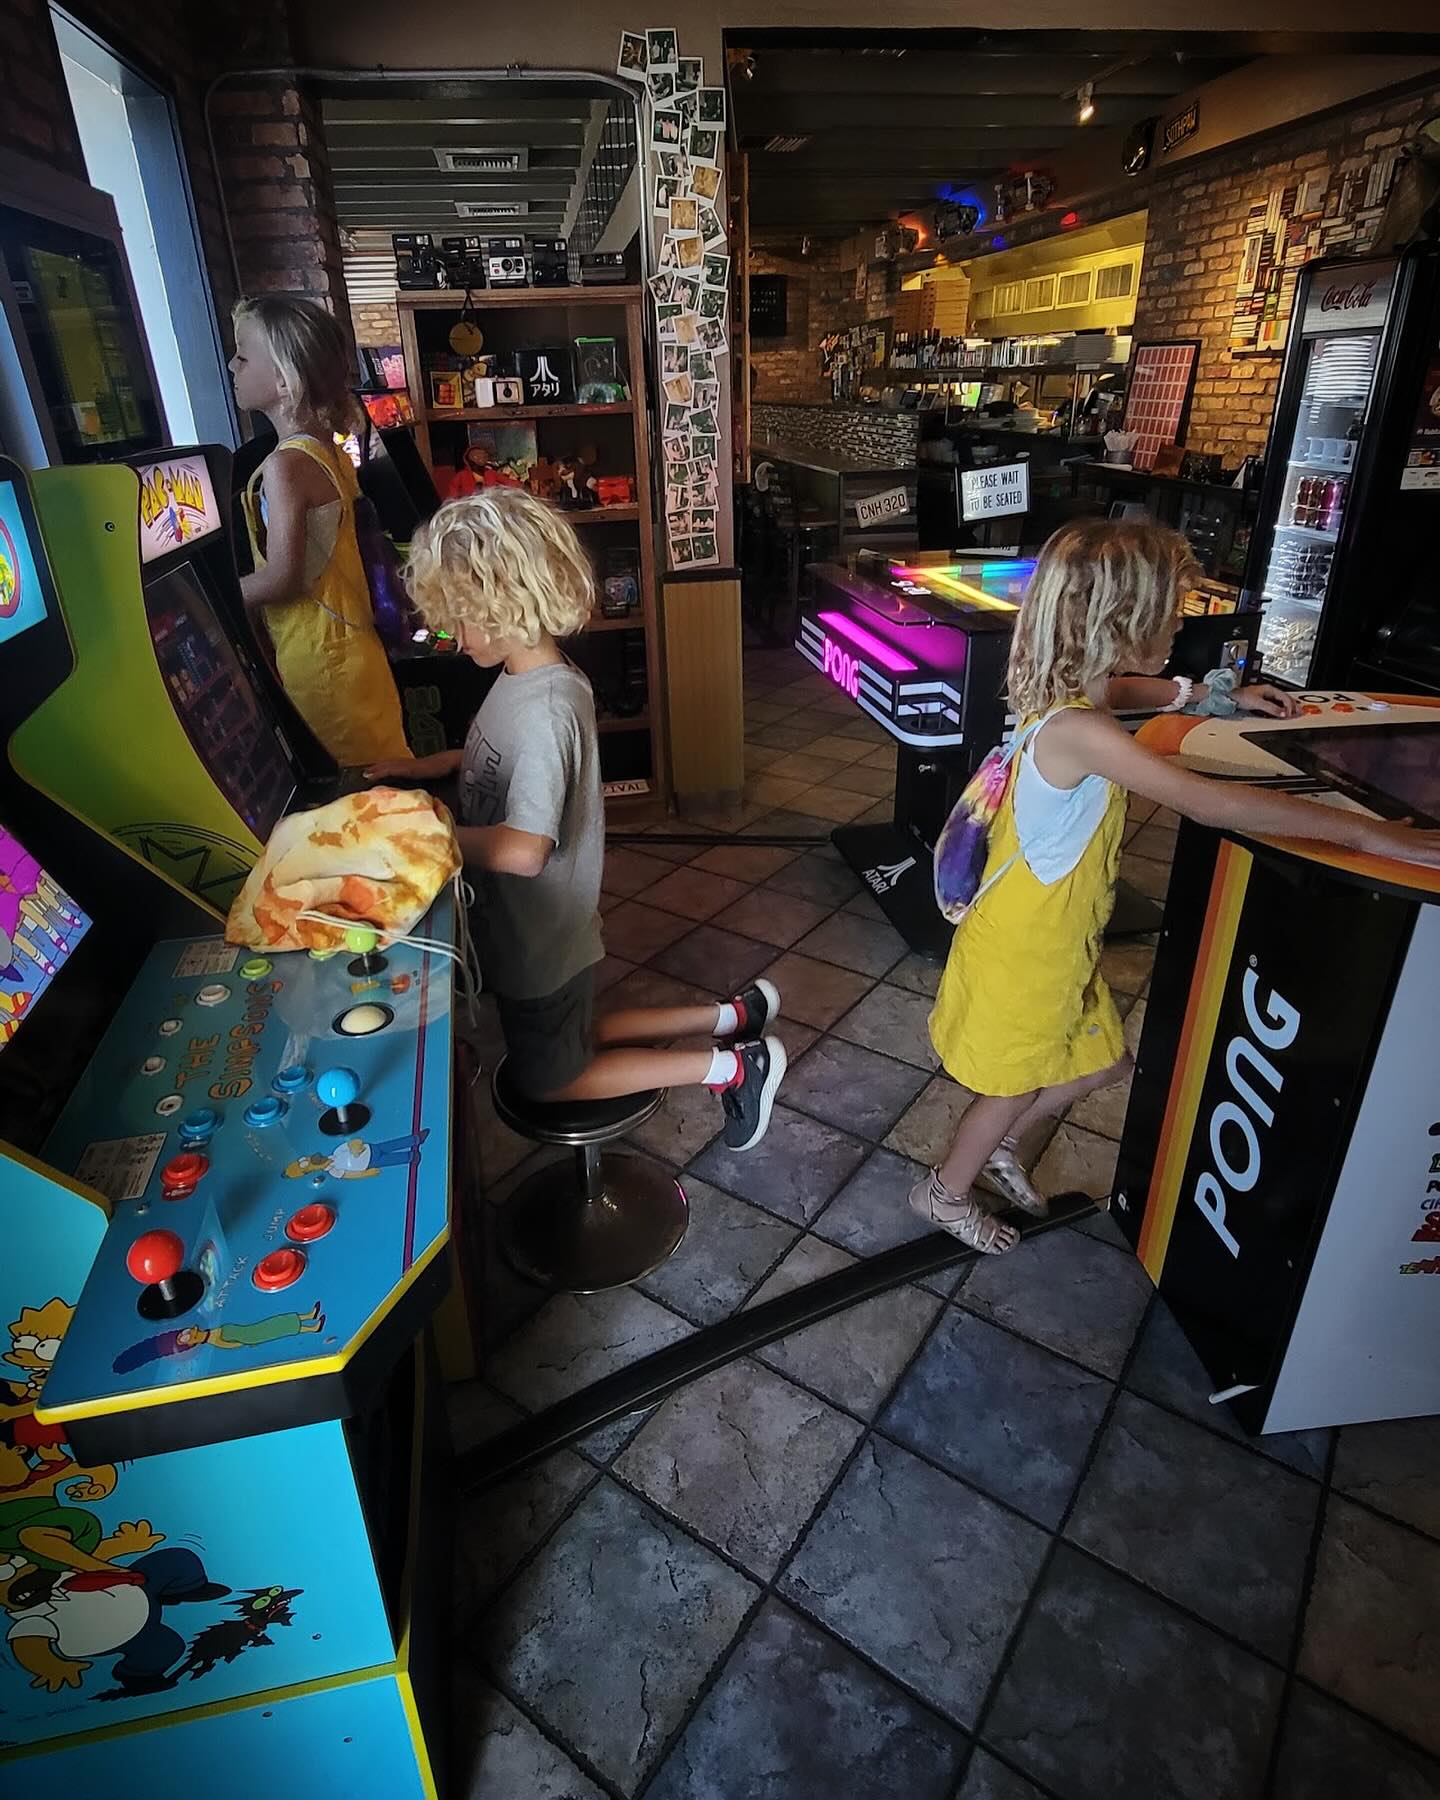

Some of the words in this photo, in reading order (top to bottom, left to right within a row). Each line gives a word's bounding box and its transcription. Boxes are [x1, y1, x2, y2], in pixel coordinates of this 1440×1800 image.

[1321, 281, 1376, 312] Coca-Cola
[530, 383, 560, 397] アタリ
[971, 473, 998, 490] PLEASE
[1001, 470, 1019, 486] WAIT
[860, 501, 883, 520] CNH
[883, 493, 906, 513] 320
[970, 497, 980, 511] TO
[983, 495, 992, 508] BE
[996, 490, 1023, 507] SEATED
[825, 638, 859, 698] PONG
[862, 868, 890, 894] ATARI
[208, 980, 284, 1100] SIMPSONS
[175, 1034, 221, 1090] THE
[1194, 967, 1301, 1260] PONG
[264, 1208, 285, 1241] JUMP
[215, 1255, 249, 1310] ATTACK
